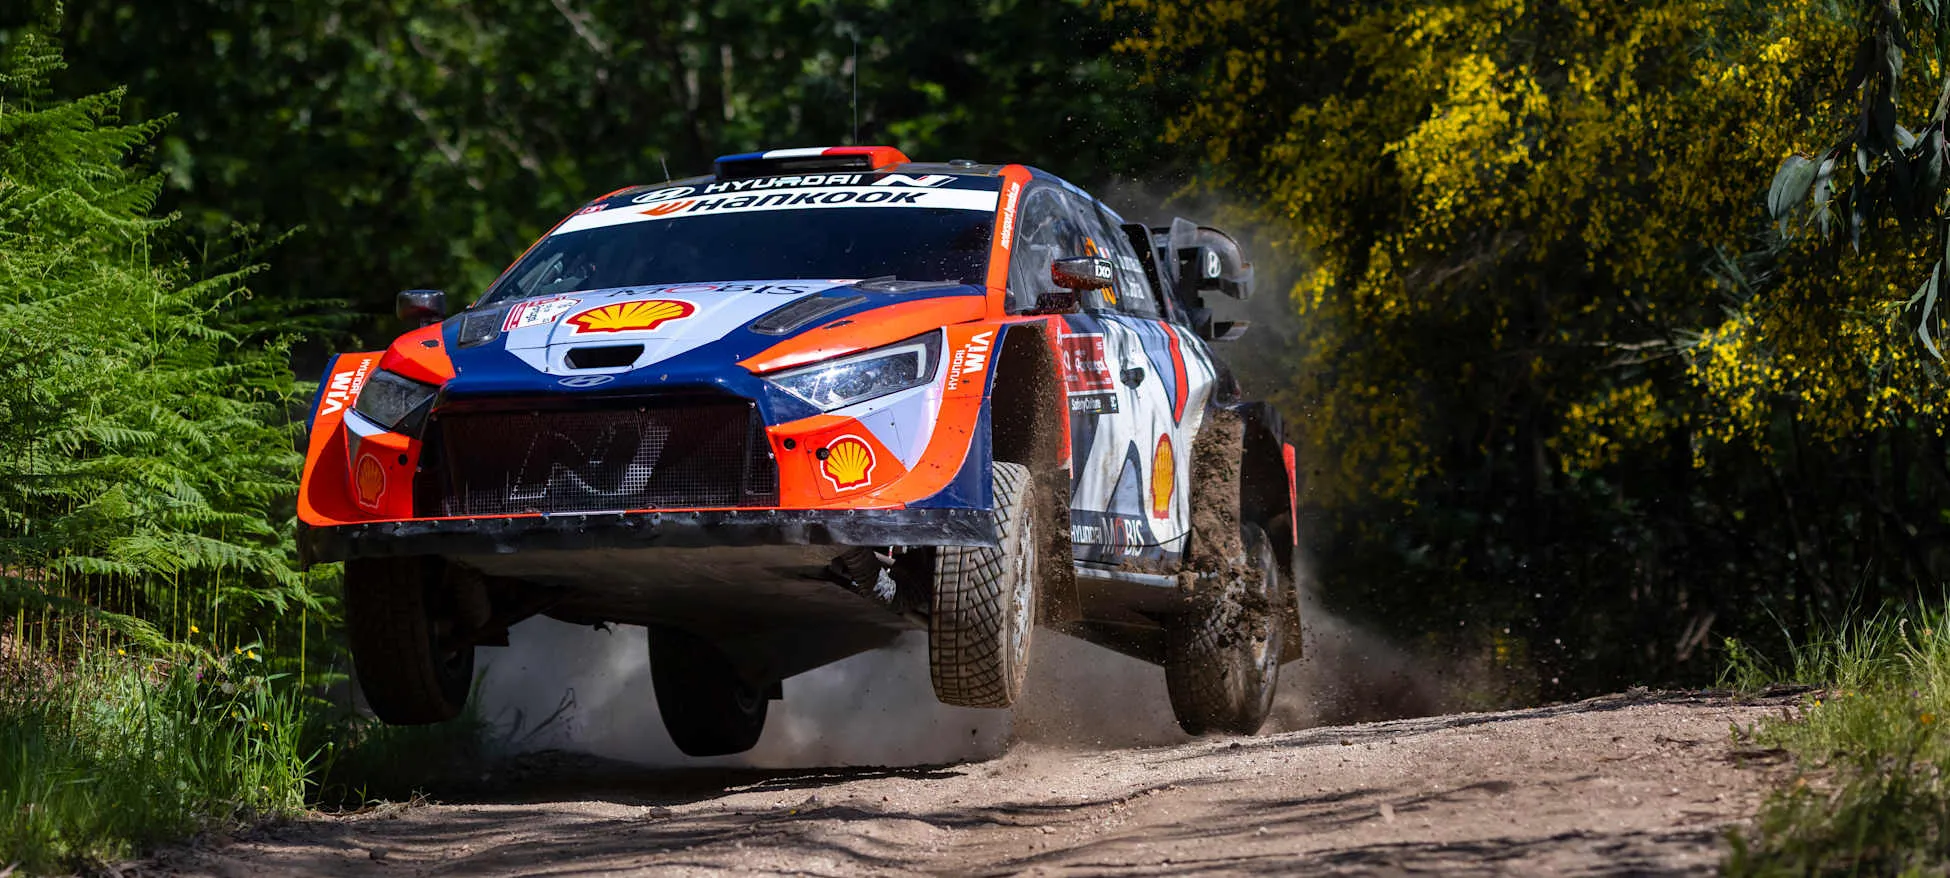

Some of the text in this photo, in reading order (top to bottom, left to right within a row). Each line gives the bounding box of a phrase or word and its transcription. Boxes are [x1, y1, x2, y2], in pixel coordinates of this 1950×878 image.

[703, 175, 862, 193] HYUNDAI
[1094, 259, 1112, 279] ixo
[948, 349, 965, 390] HYUNDAI
[1071, 517, 1145, 557] HYUNDAI MOBIS
